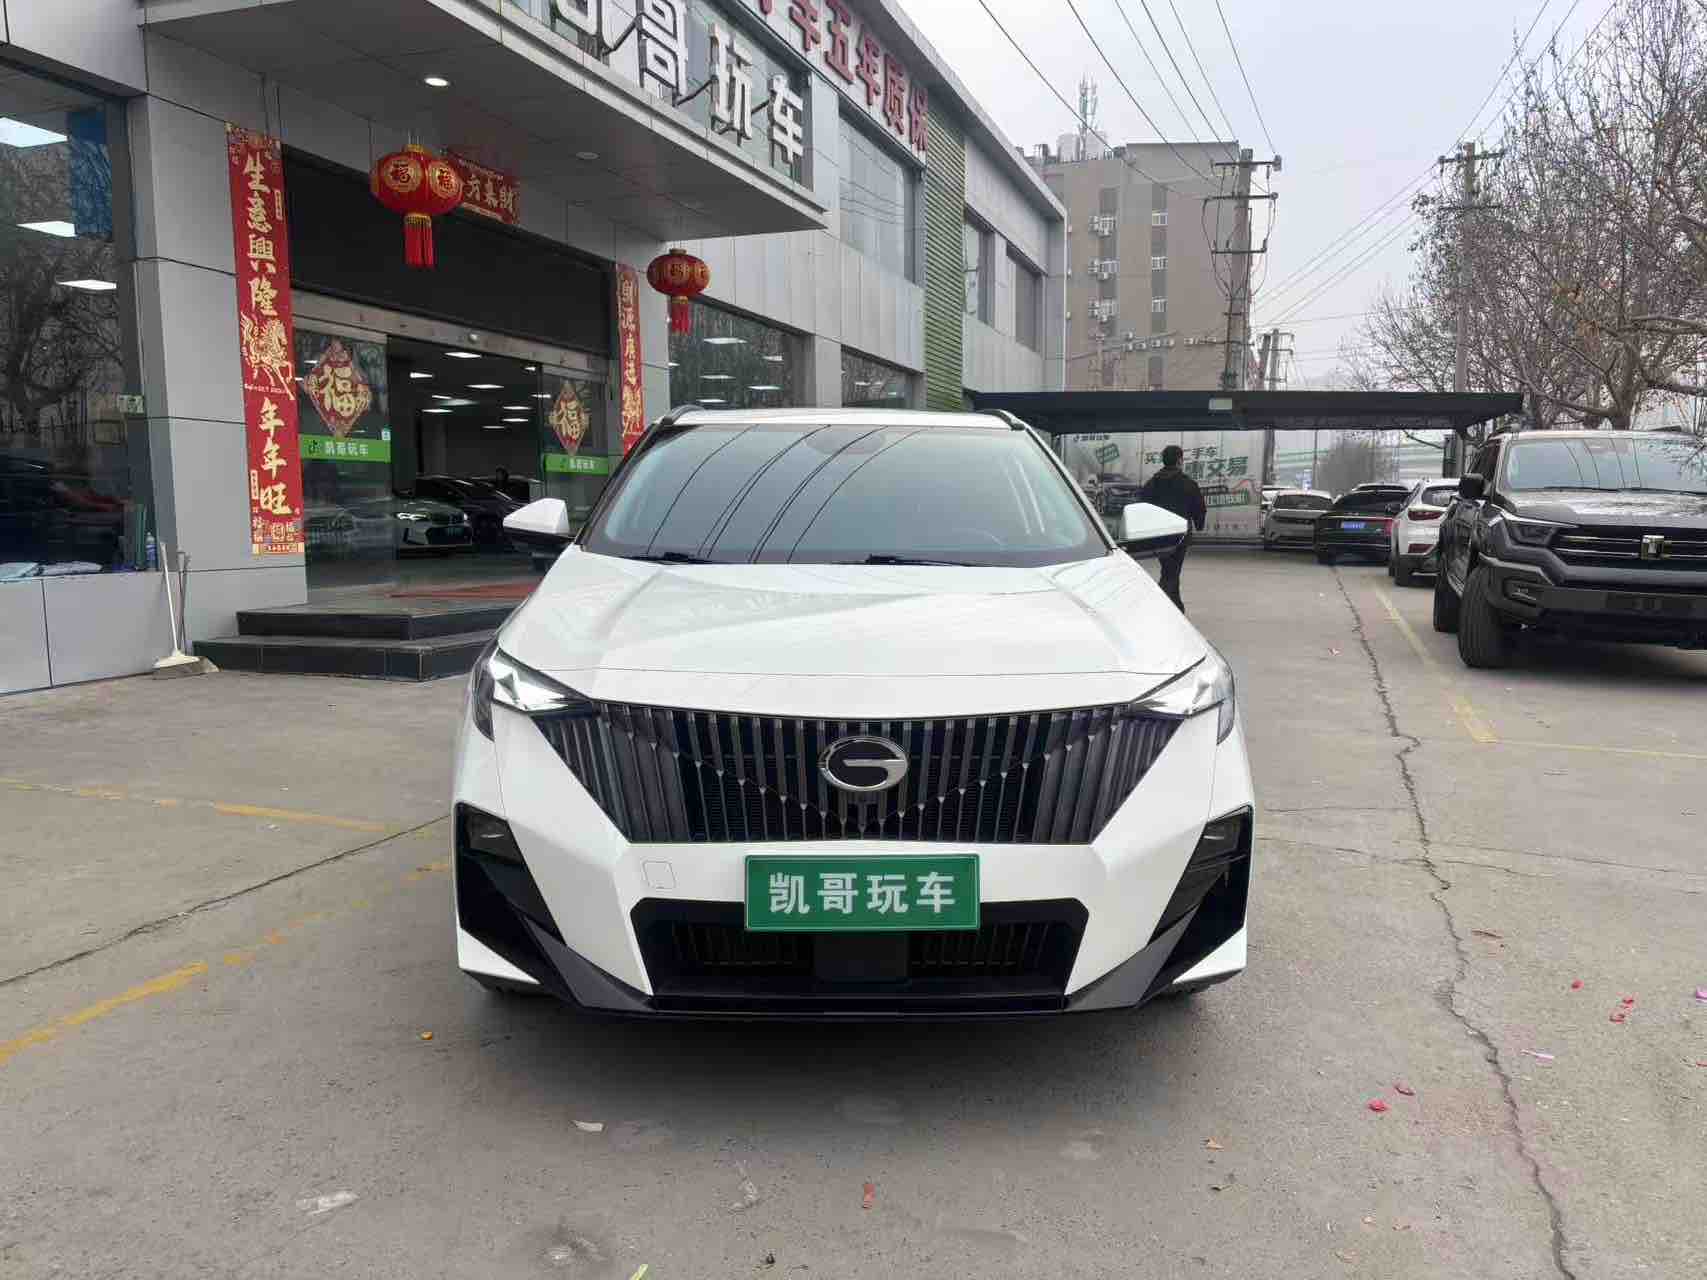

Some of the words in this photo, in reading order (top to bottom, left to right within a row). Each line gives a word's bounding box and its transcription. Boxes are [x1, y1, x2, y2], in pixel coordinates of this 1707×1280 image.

[320, 363, 355, 417] 福
[258, 397, 293, 515] 年年旺
[768, 871, 956, 915] 凯哥玩车
